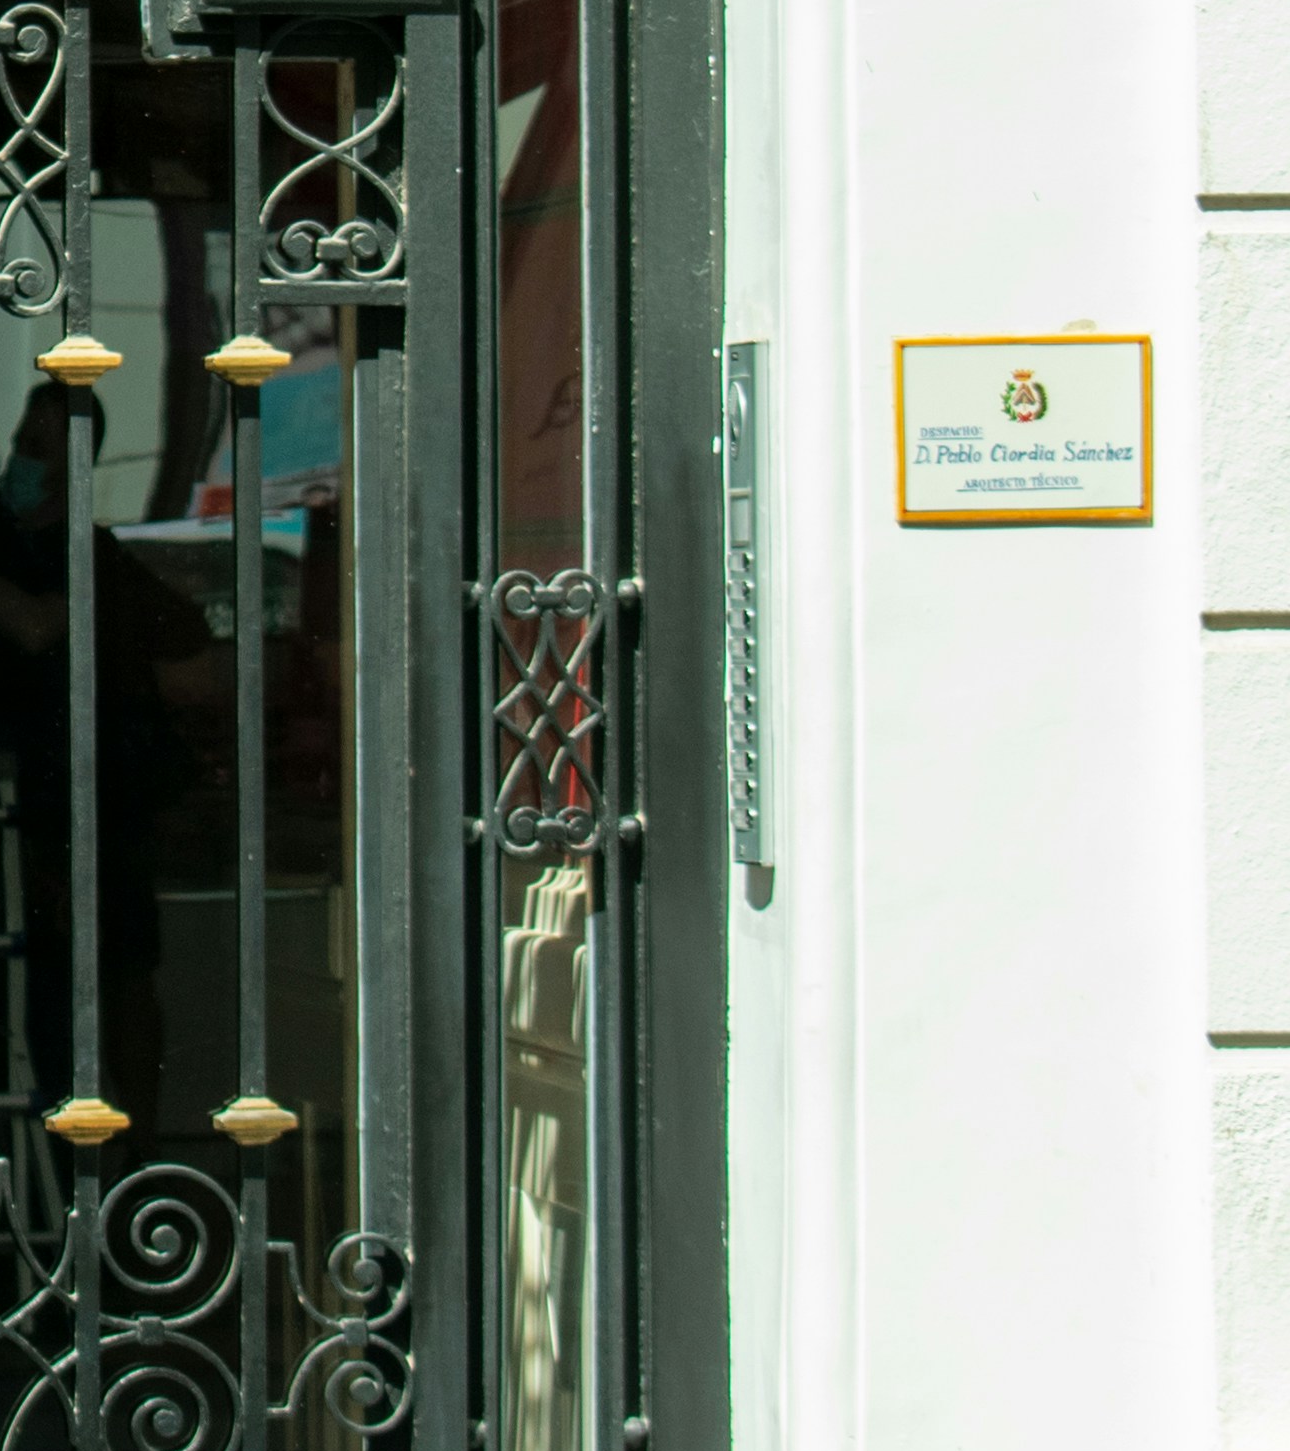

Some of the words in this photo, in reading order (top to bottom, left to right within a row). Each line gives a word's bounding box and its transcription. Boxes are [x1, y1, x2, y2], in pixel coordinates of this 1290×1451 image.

[935, 443, 982, 465] Pablo
[989, 442, 1056, 463] Ciordia
[1063, 439, 1134, 462] Sánchez
